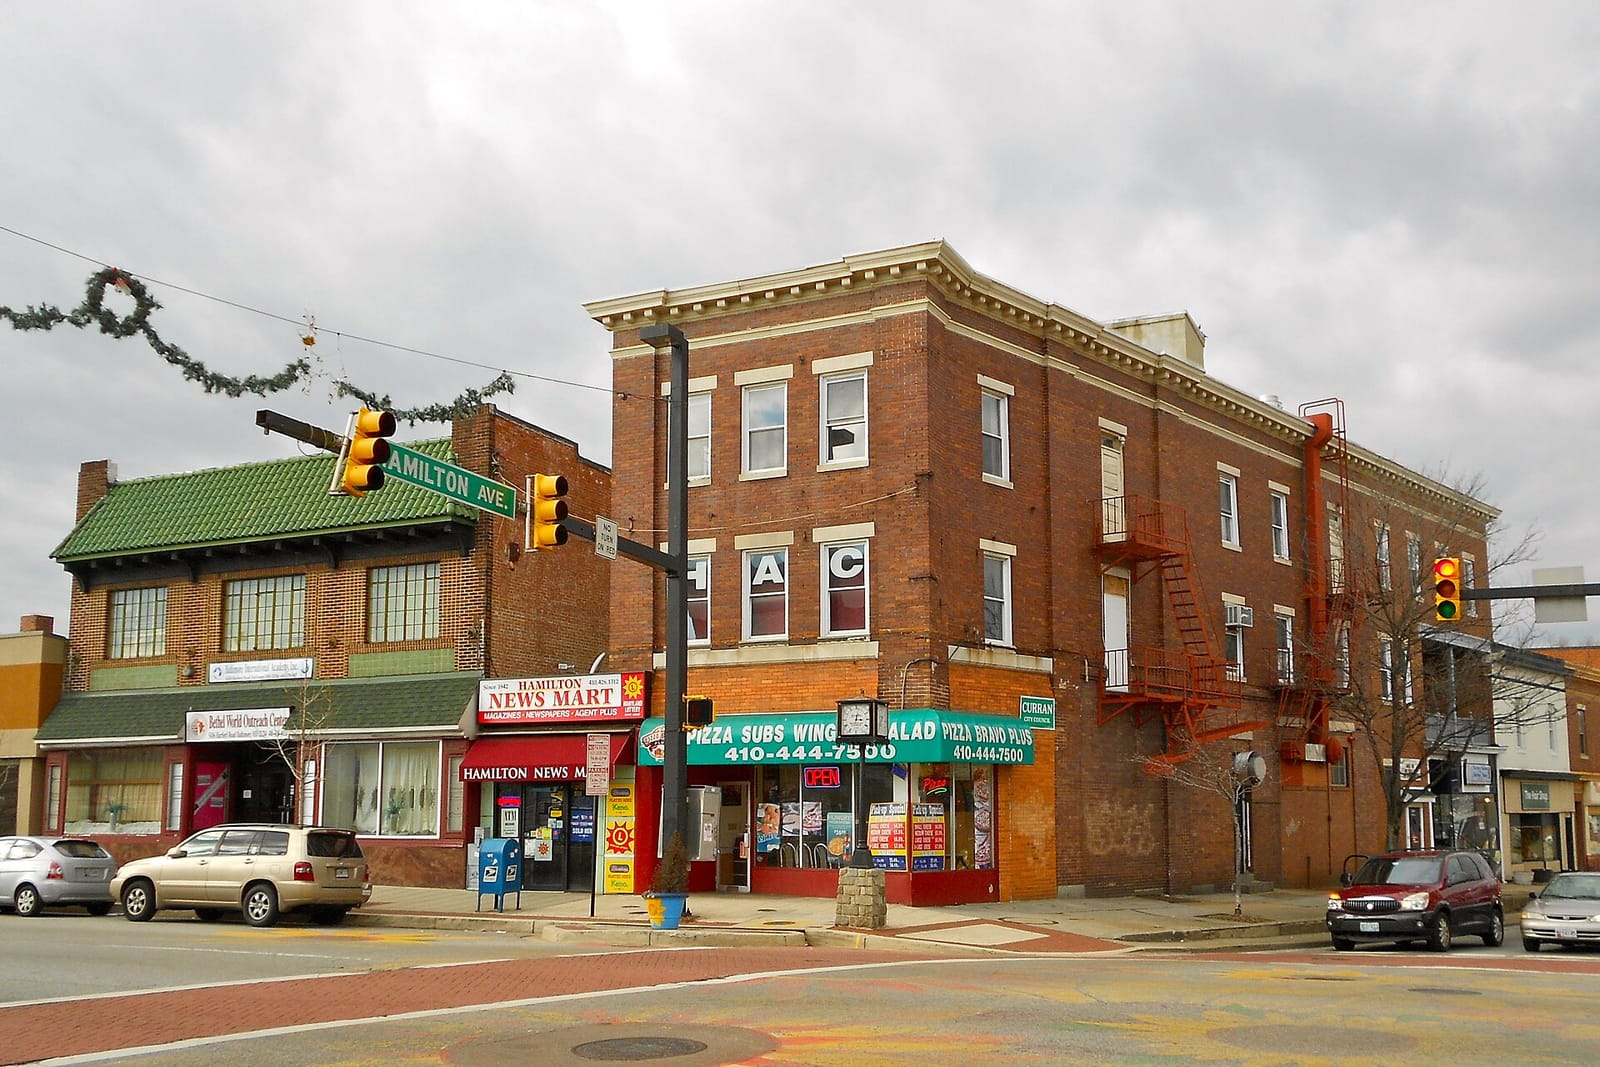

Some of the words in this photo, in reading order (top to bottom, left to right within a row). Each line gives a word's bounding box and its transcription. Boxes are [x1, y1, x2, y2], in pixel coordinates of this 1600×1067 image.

[383, 449, 468, 497] AMILTON
[477, 485, 508, 510] AVE.
[603, 523, 611, 532] NO
[601, 532, 614, 543] TURN
[598, 542, 604, 551] ON
[606, 545, 615, 555] RED
[518, 678, 582, 690] HAMILTON
[489, 691, 545, 709] NEWS
[553, 688, 614, 707] MART
[484, 711, 522, 720] MAGAZINES
[526, 710, 570, 718] NEWSPAPERS
[574, 708, 598, 716] AGENT
[600, 708, 617, 716] PLUS
[1022, 702, 1053, 714] CURRAN
[208, 715, 226, 729] Bethel
[226, 714, 242, 728] World
[243, 713, 268, 728] Outreach
[686, 726, 732, 744] PIZZA
[742, 724, 784, 743] SUBS
[794, 724, 836, 742] WING
[888, 722, 936, 740] ALAD
[941, 722, 972, 742] PIZZA
[974, 725, 1006, 744] BRAVO
[1008, 727, 1033, 746] PLUS
[953, 745, 1024, 762] 410-444-7500
[464, 768, 528, 780] HAMILTON
[534, 766, 568, 778] NEWS
[806, 769, 838, 786] OPEN
